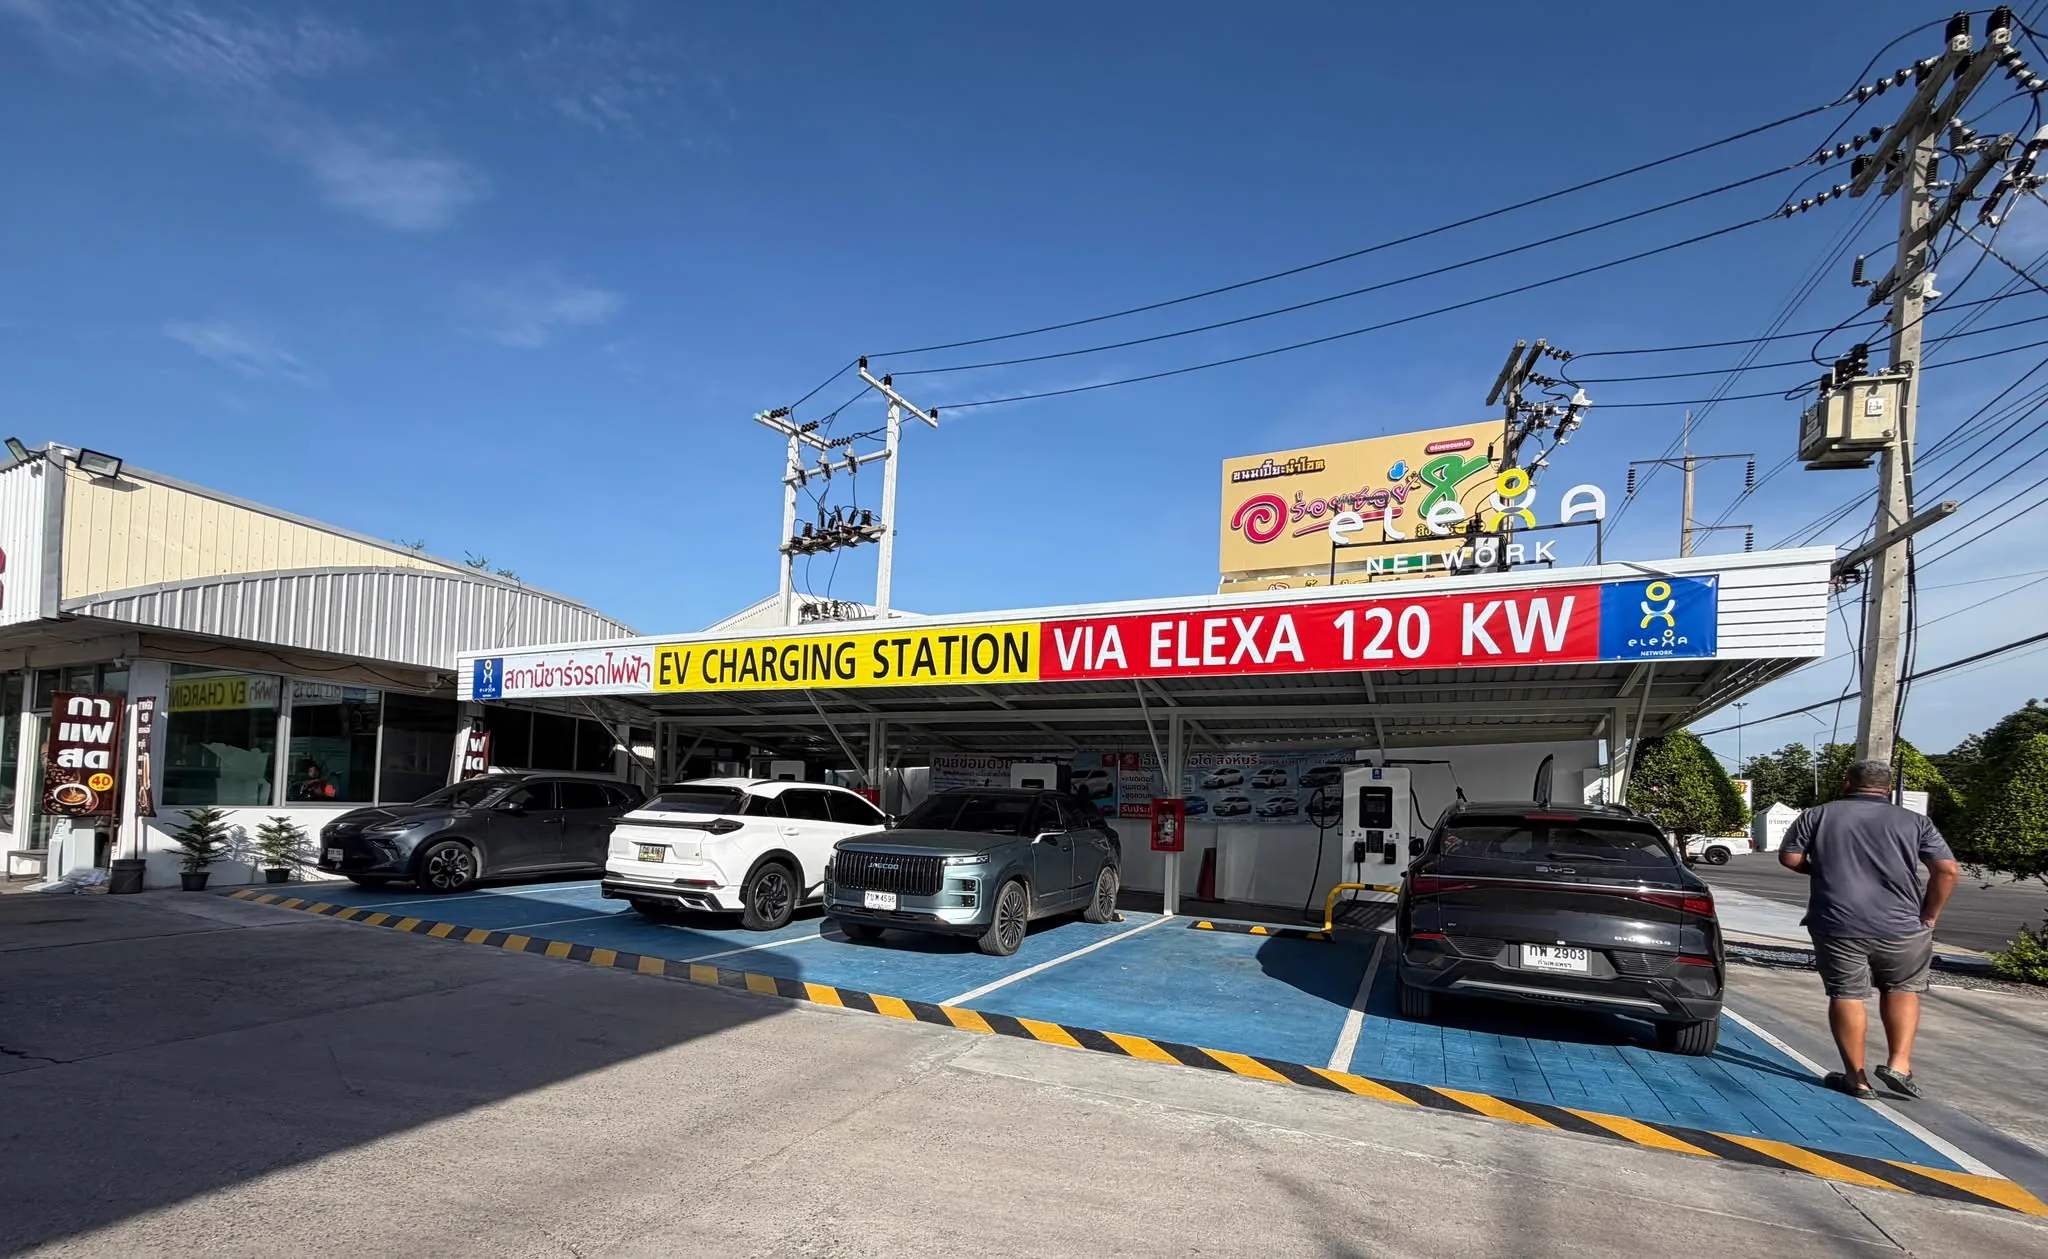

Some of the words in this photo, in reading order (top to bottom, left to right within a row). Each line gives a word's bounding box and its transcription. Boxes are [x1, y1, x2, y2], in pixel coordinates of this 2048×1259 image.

[1365, 539, 1557, 576] NETWORK
[1054, 624, 1128, 671] VIA
[1150, 613, 1305, 668] ELEXA
[1333, 604, 1431, 660] 120
[1461, 594, 1576, 656] KW
[660, 650, 692, 685] EV
[702, 640, 856, 684] CHARGING
[873, 631, 1029, 679] STATION
[504, 652, 652, 690] สถานีชาร์จรถไฟฟ้า
[67, 697, 111, 718] กา
[58, 721, 114, 743] แฟ
[57, 748, 109, 769] สด
[92, 776, 111, 787] 40
[1535, 865, 1576, 874] BYD
[1554, 947, 1585, 961] 2903
